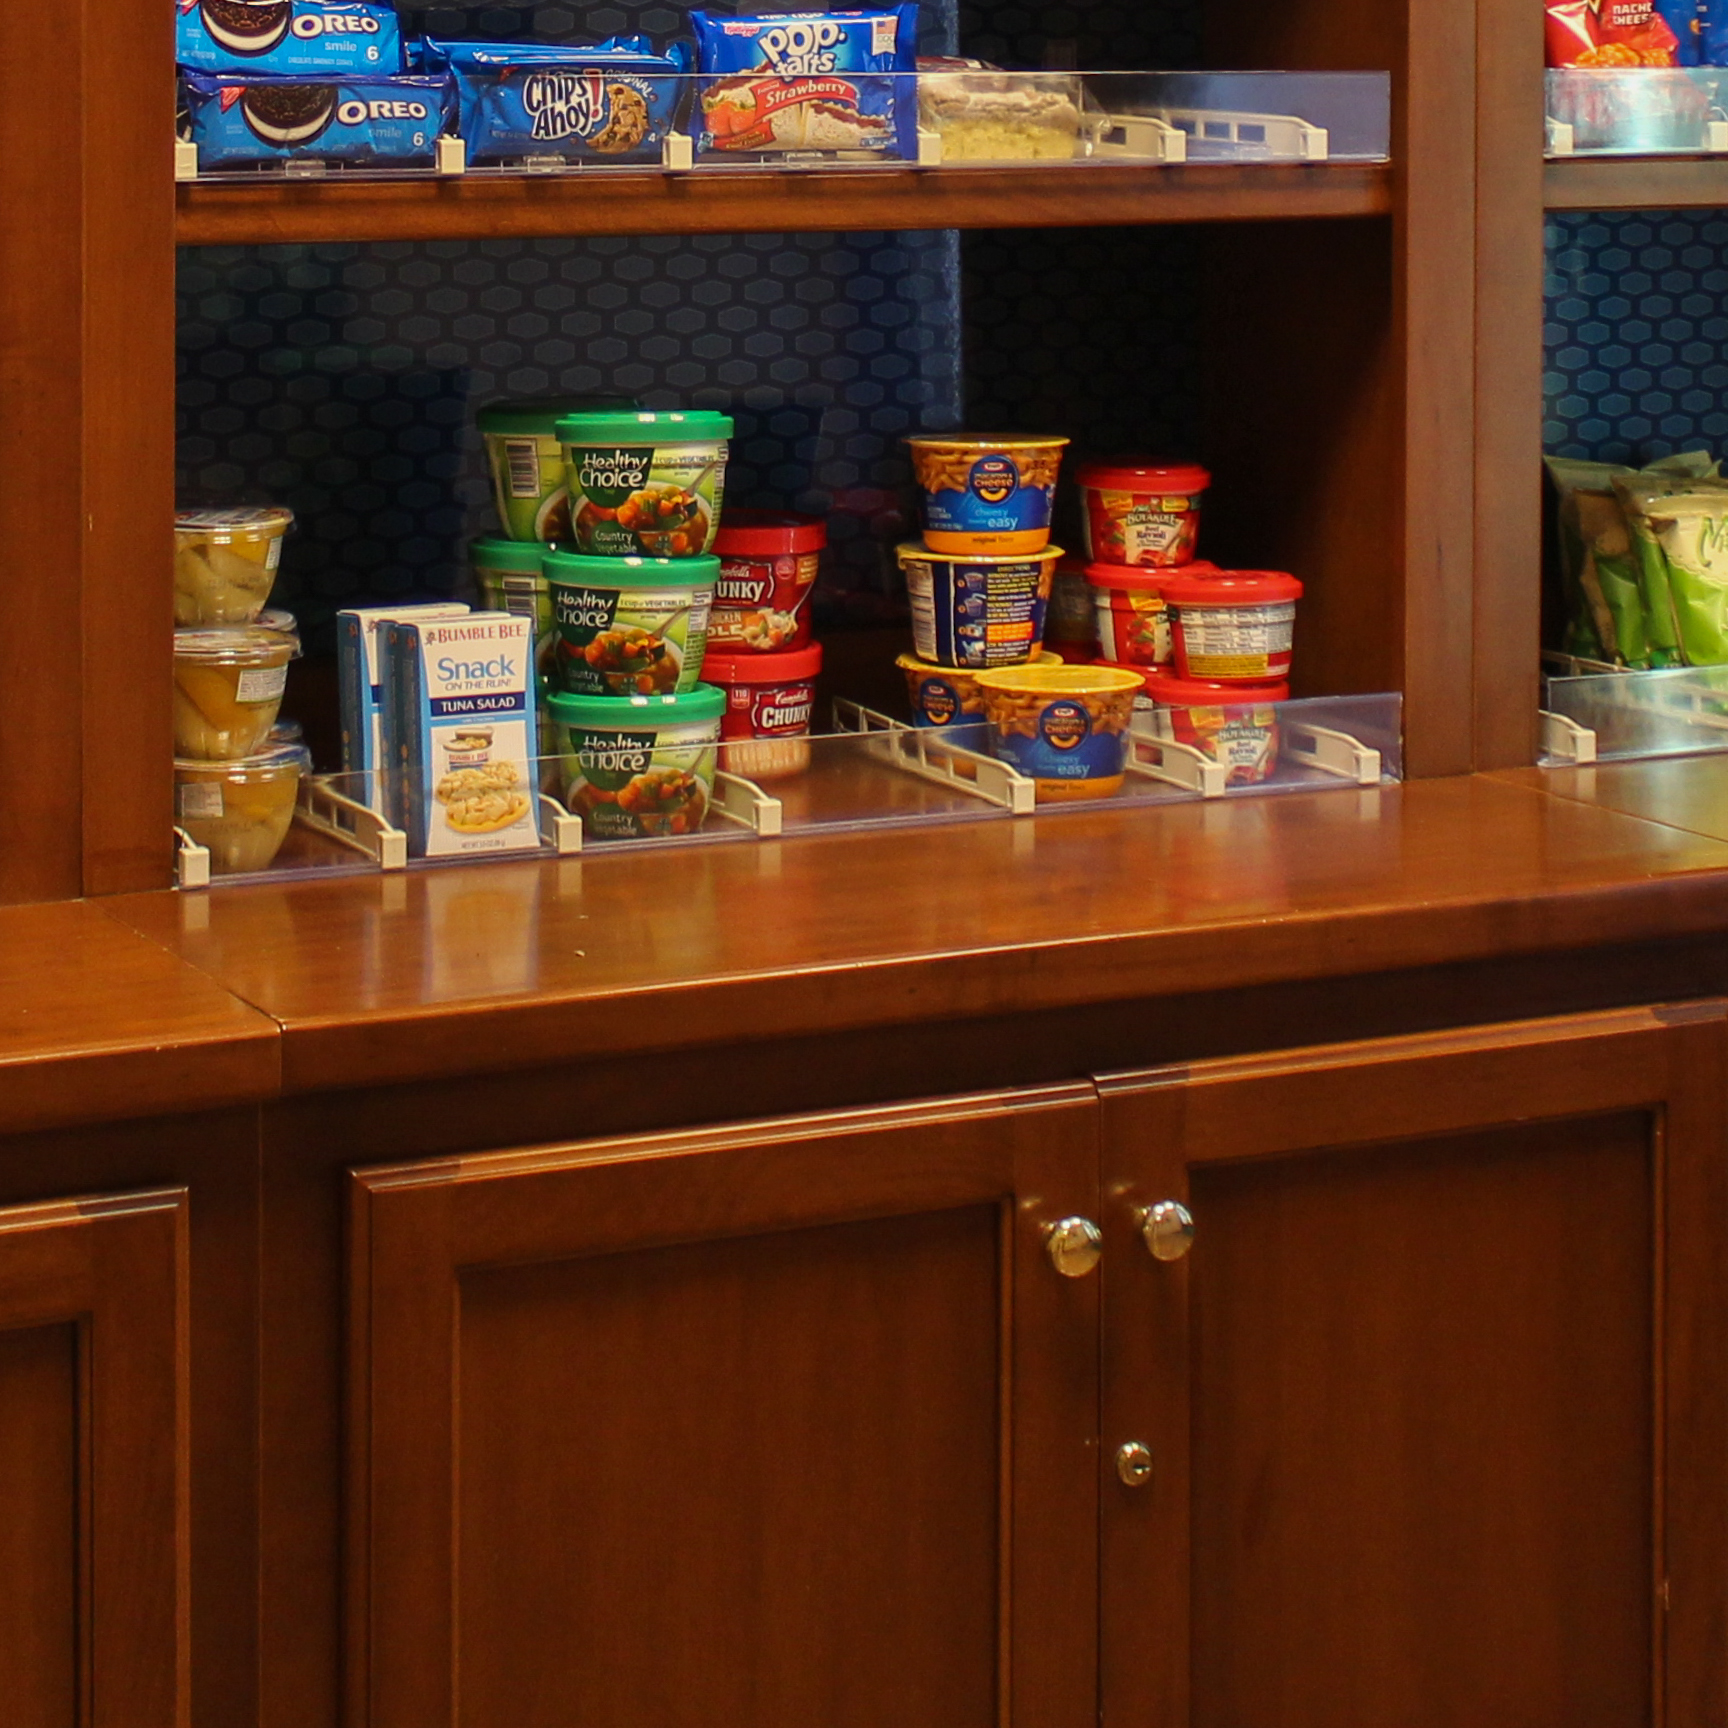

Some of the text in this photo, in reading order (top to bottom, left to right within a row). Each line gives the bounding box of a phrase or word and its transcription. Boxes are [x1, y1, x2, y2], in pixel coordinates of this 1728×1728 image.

[292, 13, 380, 40] OREO
[324, 40, 357, 52] smile
[365, 46, 379, 61] 6
[525, 72, 589, 114] Chips
[765, 79, 847, 109] Strawberry
[337, 101, 427, 127] OREO
[412, 132, 425, 146] 6
[582, 448, 650, 473] Healthy
[579, 467, 644, 489] Choice
[987, 514, 1019, 531] easy
[594, 529, 634, 546] Country
[556, 589, 615, 610] Healthy
[717, 580, 766, 603] UNKY
[554, 605, 610, 628] Choice
[437, 624, 524, 644] BUMBLE BEE
[436, 654, 515, 683] Snack
[444, 677, 511, 691] ON THE RUN!
[440, 696, 516, 713] TUNA SALAD
[582, 734, 653, 754] Healthy
[578, 748, 646, 772] Choice
[1057, 763, 1091, 779] easy
